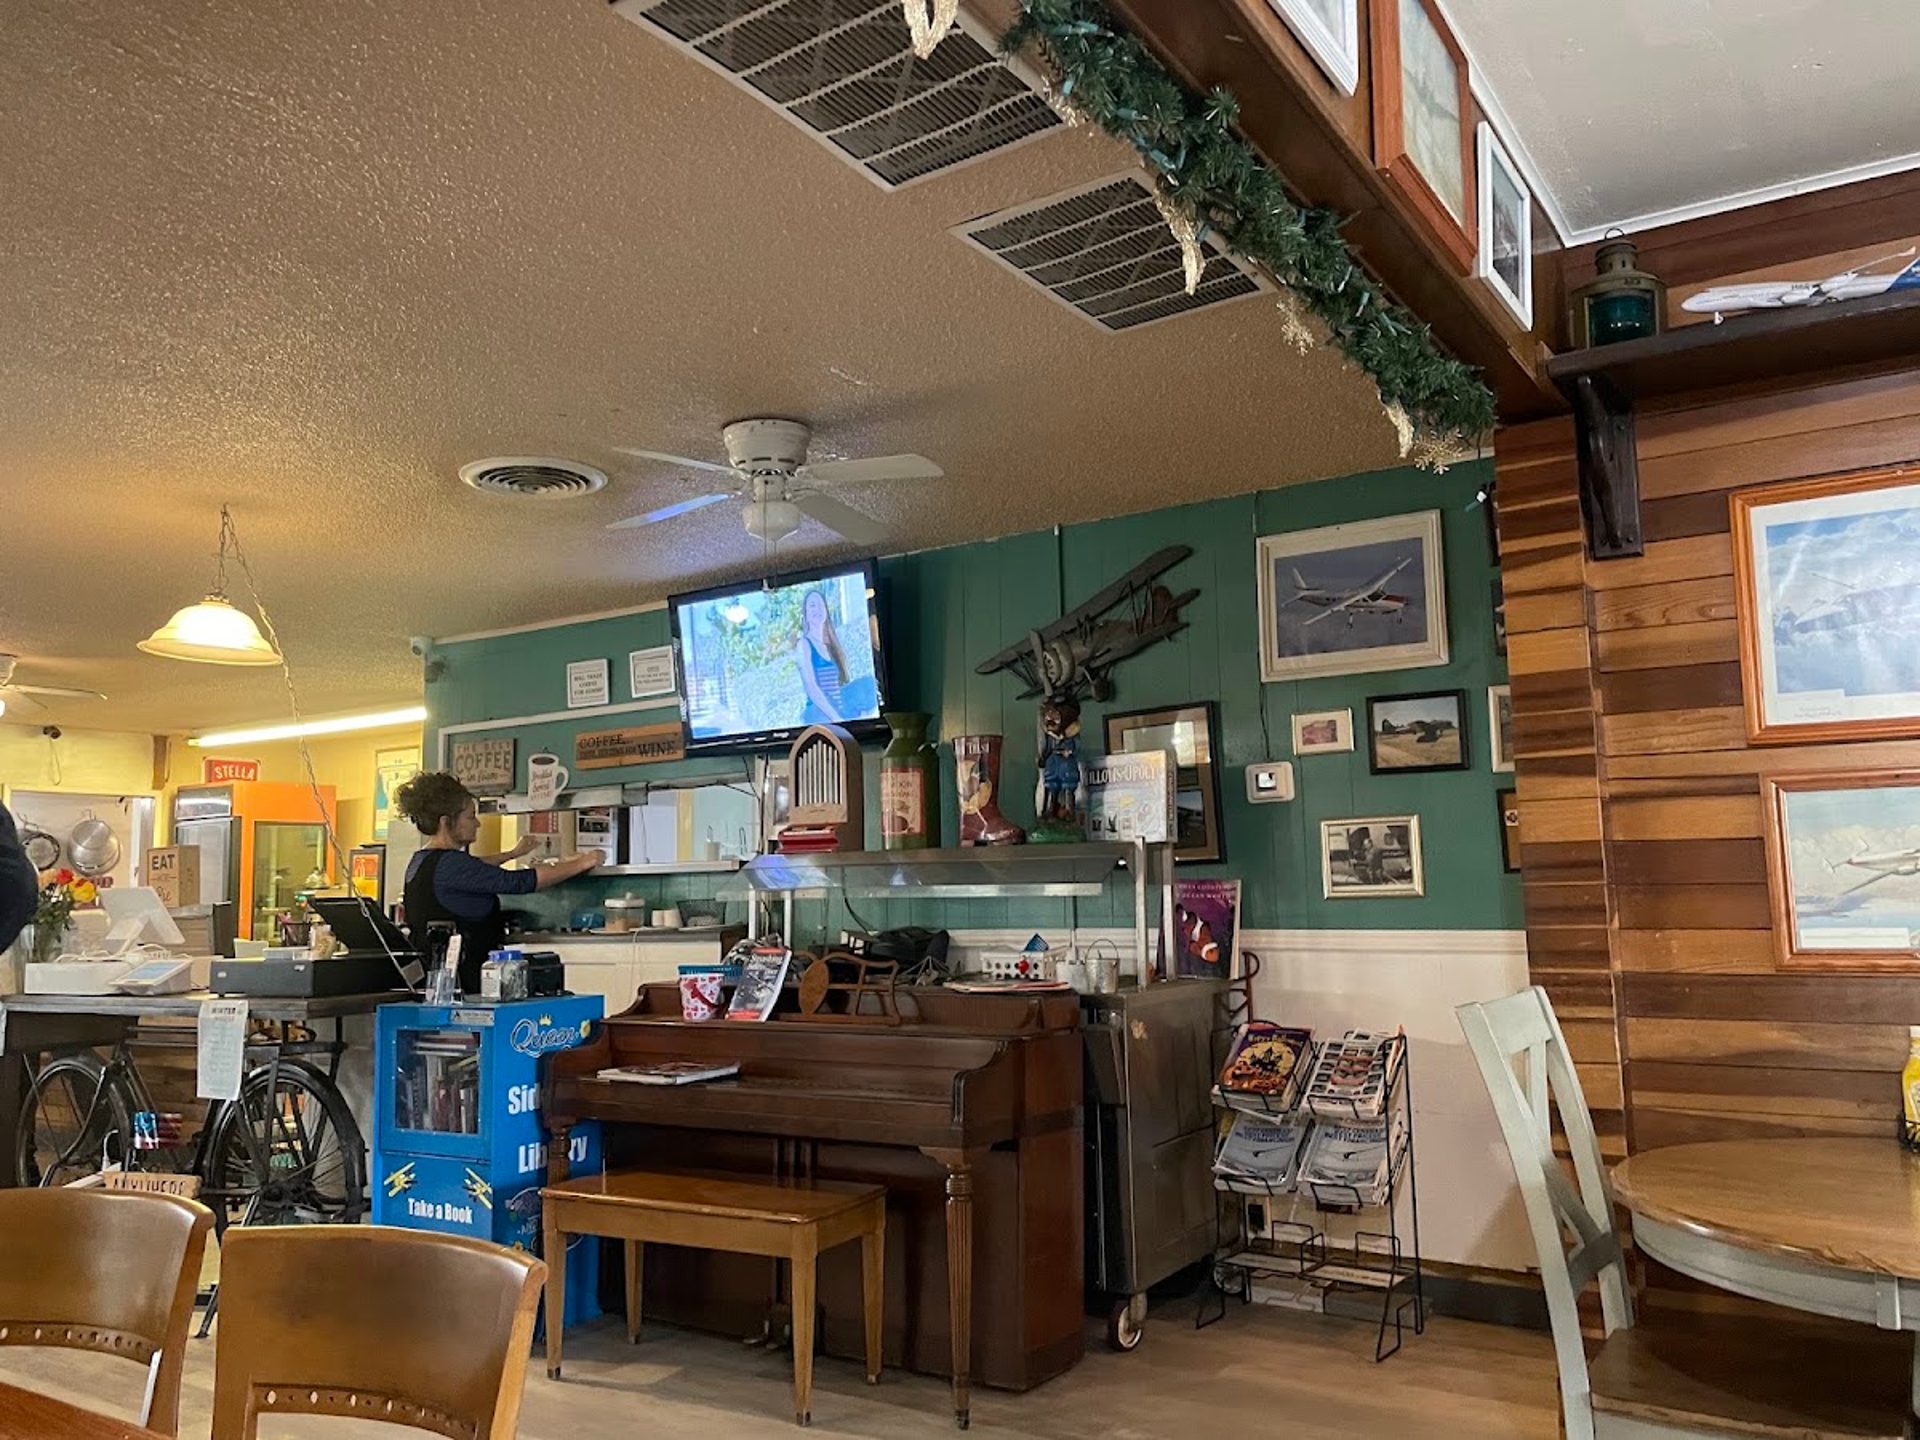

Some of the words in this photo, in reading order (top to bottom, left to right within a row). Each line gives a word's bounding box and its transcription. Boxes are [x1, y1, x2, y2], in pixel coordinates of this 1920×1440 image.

[215, 765, 255, 780] STELLA
[455, 750, 511, 774] COFFEE
[152, 854, 175, 870] EAT
[518, 1135, 588, 1174] Libry
[407, 1198, 434, 1218] Take
[435, 1204, 443, 1219] a
[444, 1203, 473, 1225] Book
